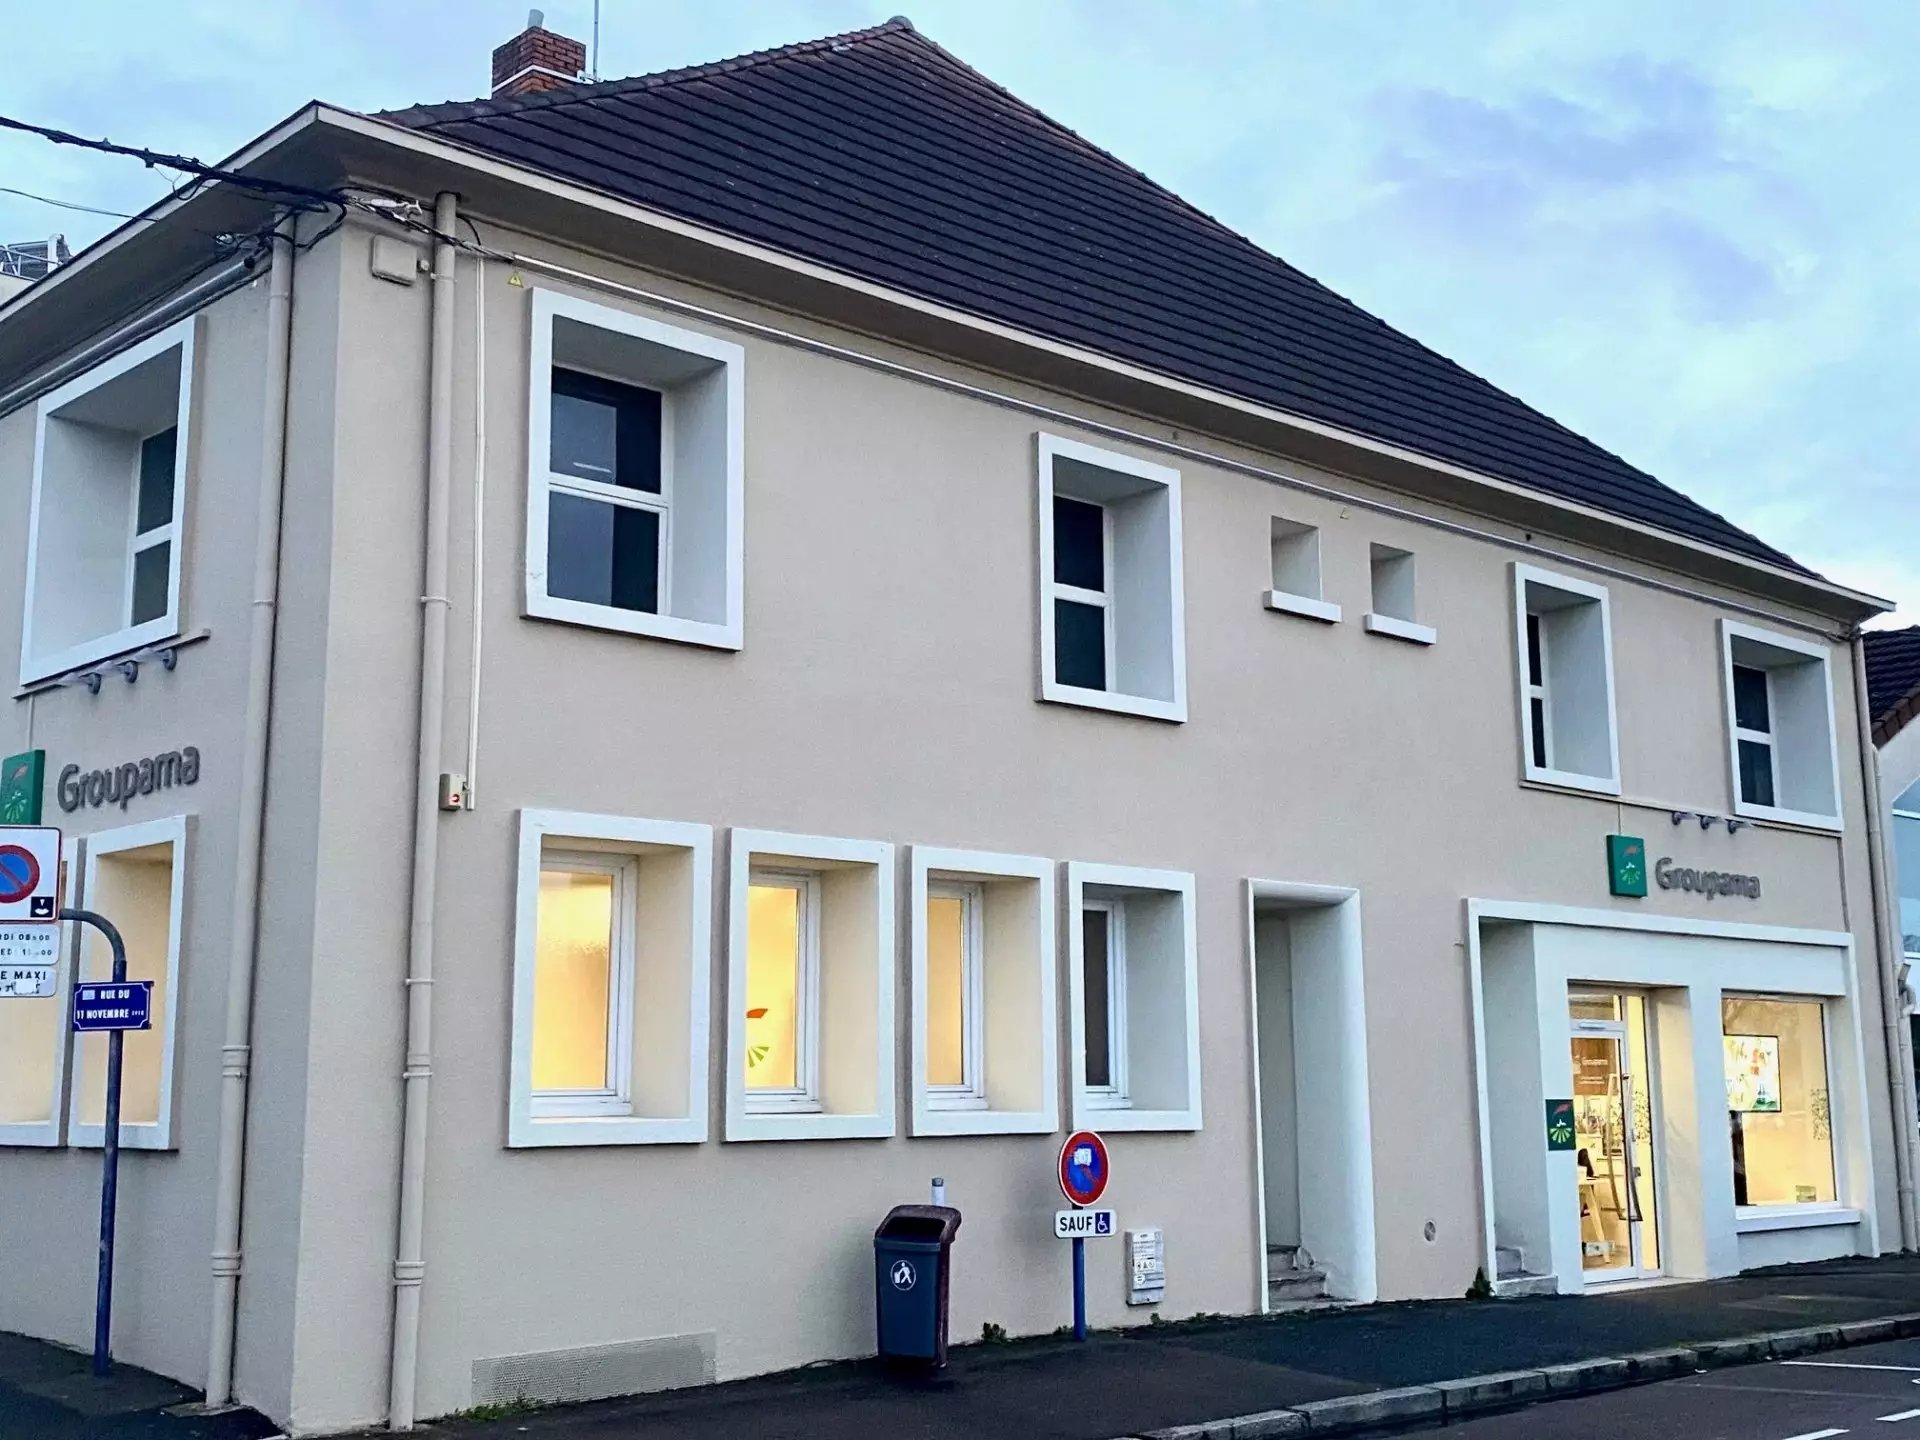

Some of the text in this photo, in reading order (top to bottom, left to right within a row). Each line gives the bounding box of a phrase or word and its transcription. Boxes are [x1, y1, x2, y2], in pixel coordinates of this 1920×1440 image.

[57, 746, 200, 813] Groupama
[1655, 857, 1760, 900] Groupama
[14, 970, 46, 980] MAXI
[101, 989, 130, 1000] RUE DU
[86, 1008, 129, 1019] NOVEMBRE
[1060, 1216, 1093, 1232] SAUF
